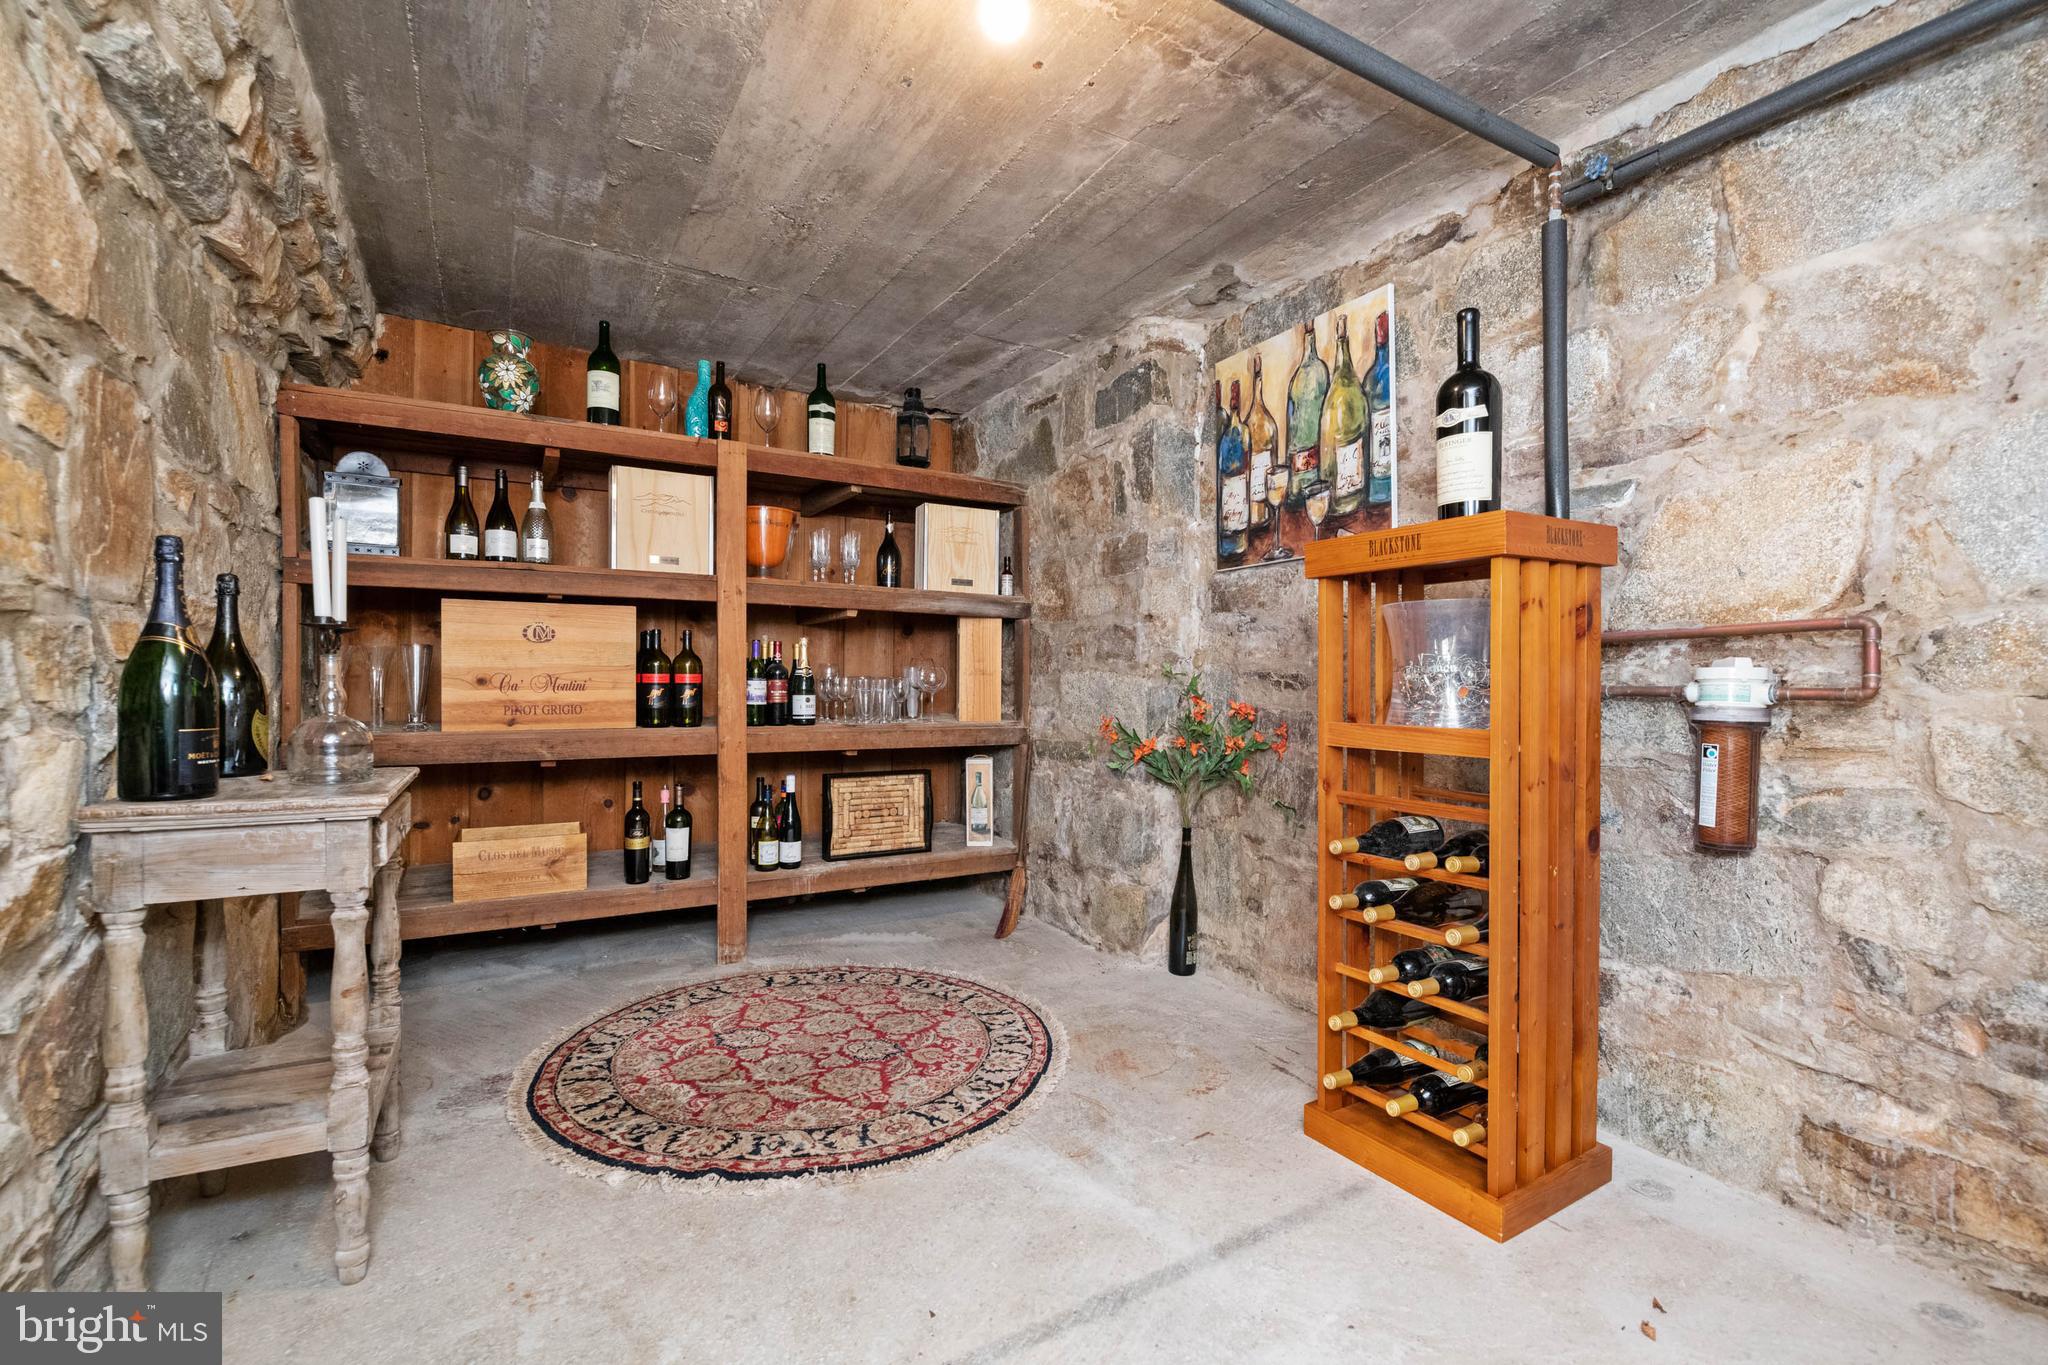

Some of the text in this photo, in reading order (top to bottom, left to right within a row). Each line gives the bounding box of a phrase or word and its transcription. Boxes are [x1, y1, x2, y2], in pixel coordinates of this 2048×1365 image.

[1546, 525, 1584, 547] BLACKSTONE
[1368, 533, 1421, 557] BLACKSTONE
[503, 704, 583, 716] PINOT GRIGIO
[478, 849, 506, 862] CLOS
